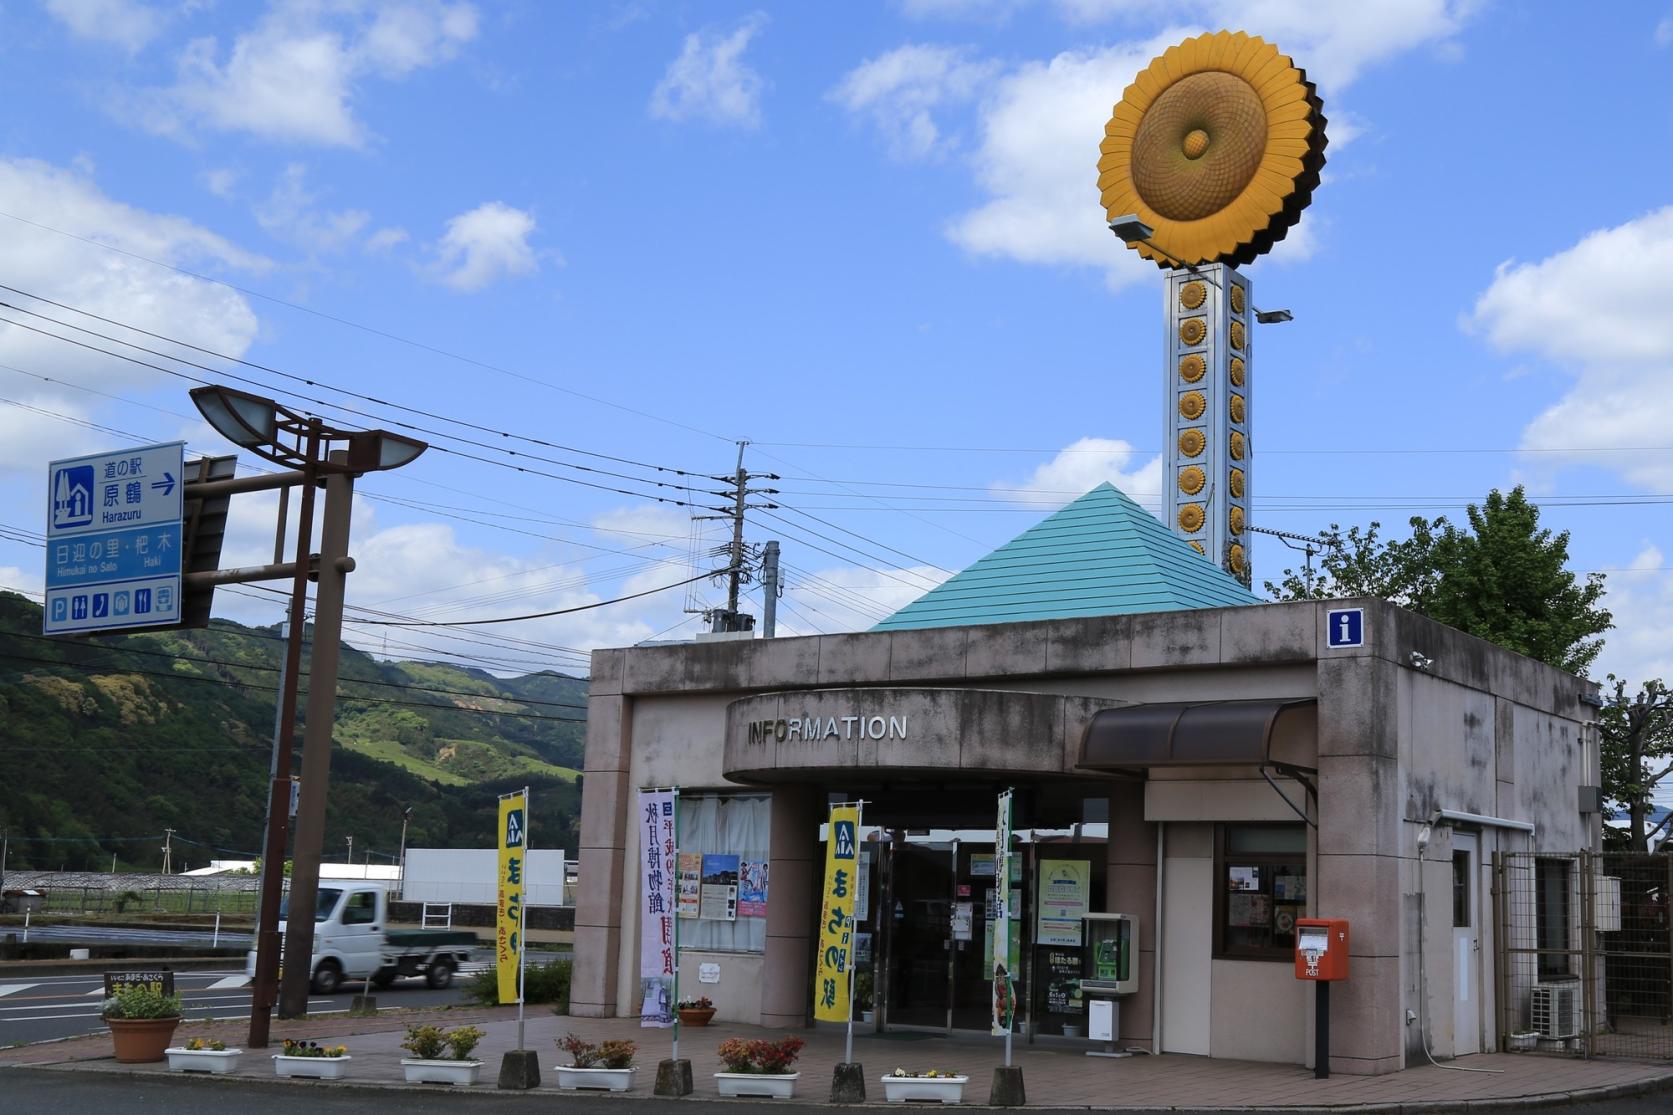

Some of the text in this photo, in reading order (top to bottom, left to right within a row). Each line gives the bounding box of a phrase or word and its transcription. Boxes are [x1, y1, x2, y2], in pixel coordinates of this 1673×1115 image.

[103, 457, 143, 479] 道の駅
[103, 480, 142, 507] 原鶴
[102, 509, 142, 524] Harazuru
[55, 600, 65, 619] P
[748, 715, 908, 745] INFORMATION
[1305, 968, 1319, 977] POST
